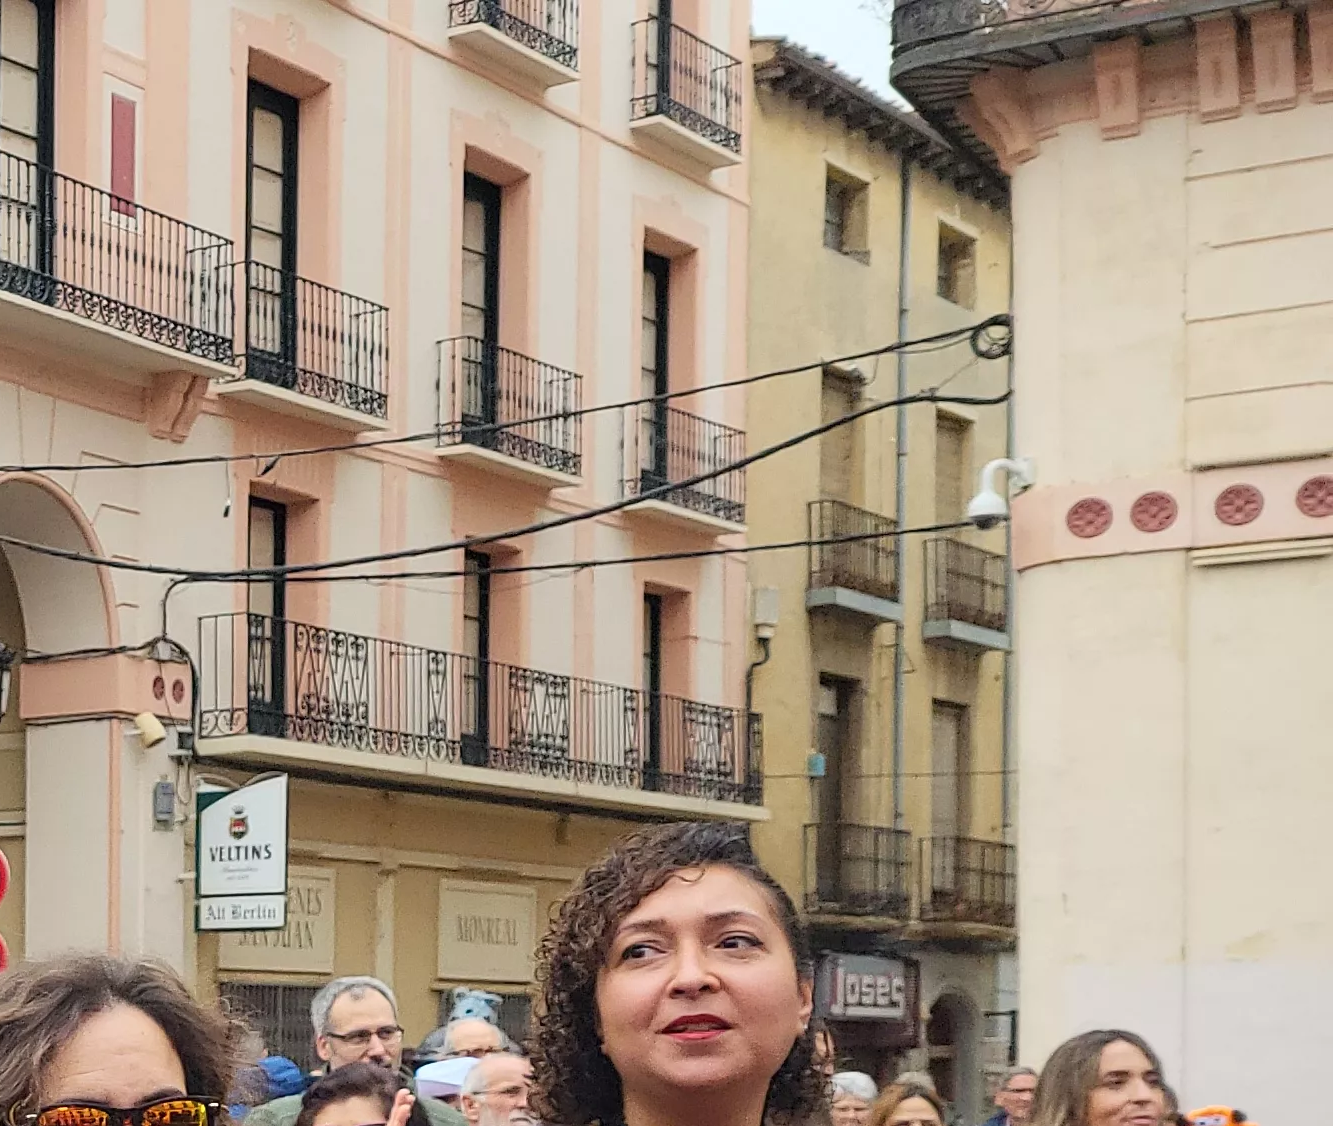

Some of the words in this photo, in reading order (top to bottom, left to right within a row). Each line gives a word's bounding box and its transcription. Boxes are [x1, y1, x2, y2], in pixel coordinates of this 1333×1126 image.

[209, 843, 273, 862] VELTINS
[231, 903, 277, 921] Berlin
[456, 914, 519, 947] MONREAL
